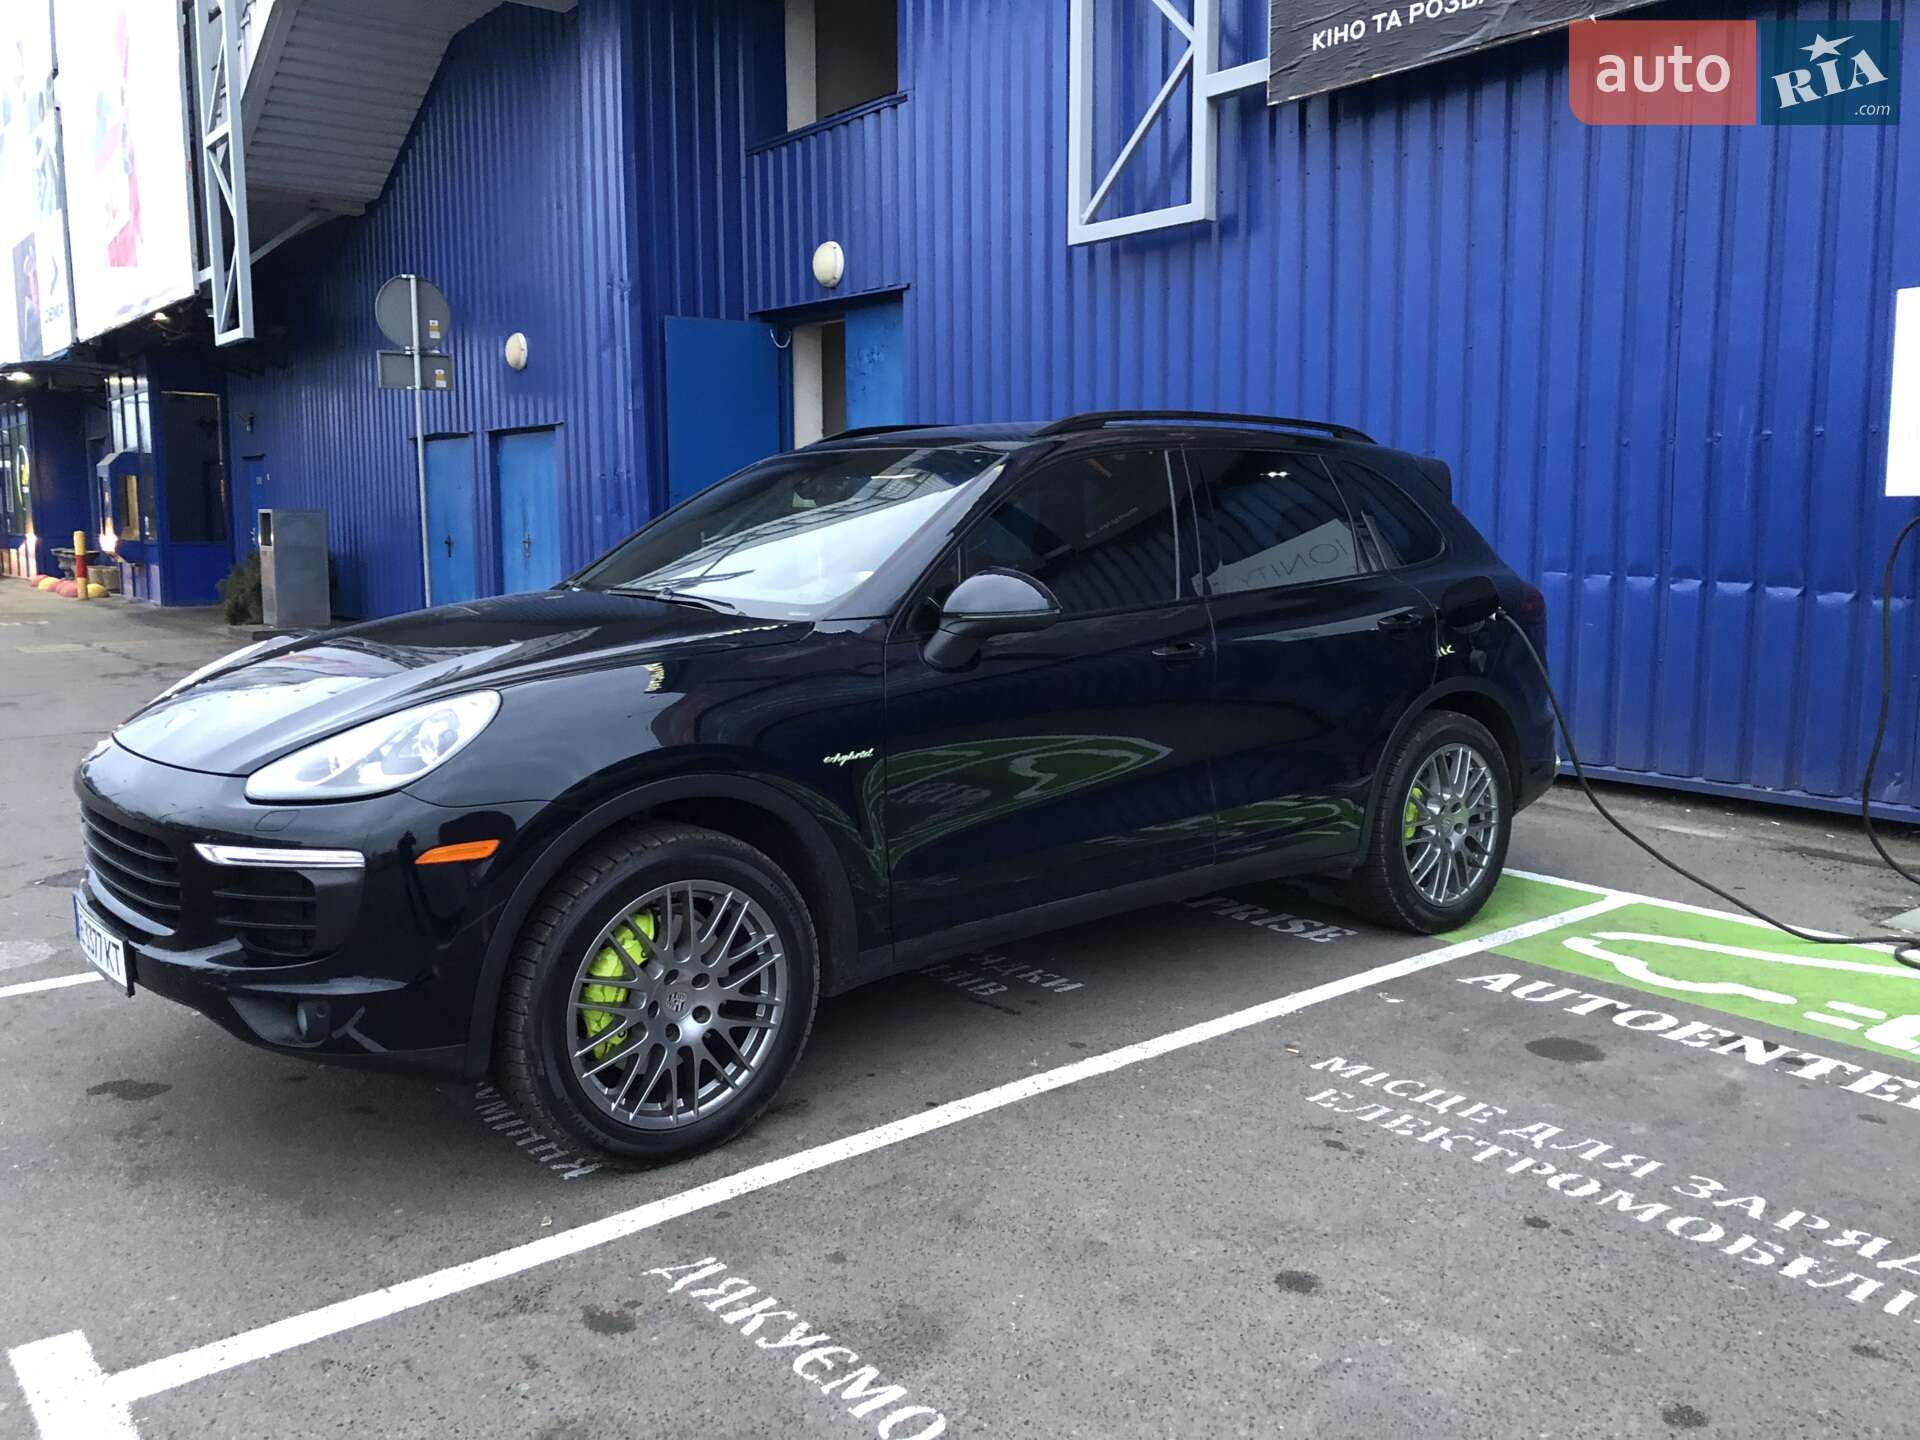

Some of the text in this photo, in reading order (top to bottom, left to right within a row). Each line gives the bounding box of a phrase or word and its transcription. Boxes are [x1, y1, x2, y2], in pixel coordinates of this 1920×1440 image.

[1311, 0, 1485, 52] КІНО ТА РОЗ
[1457, 971, 1920, 1110] AUTOENTE
[1310, 1056, 1509, 1124] МІСЦЕ
[1499, 1121, 1665, 1177] ДЛЯ
[1305, 1087, 1920, 1324] ЕЛЕКТРОМОБІЛІ
